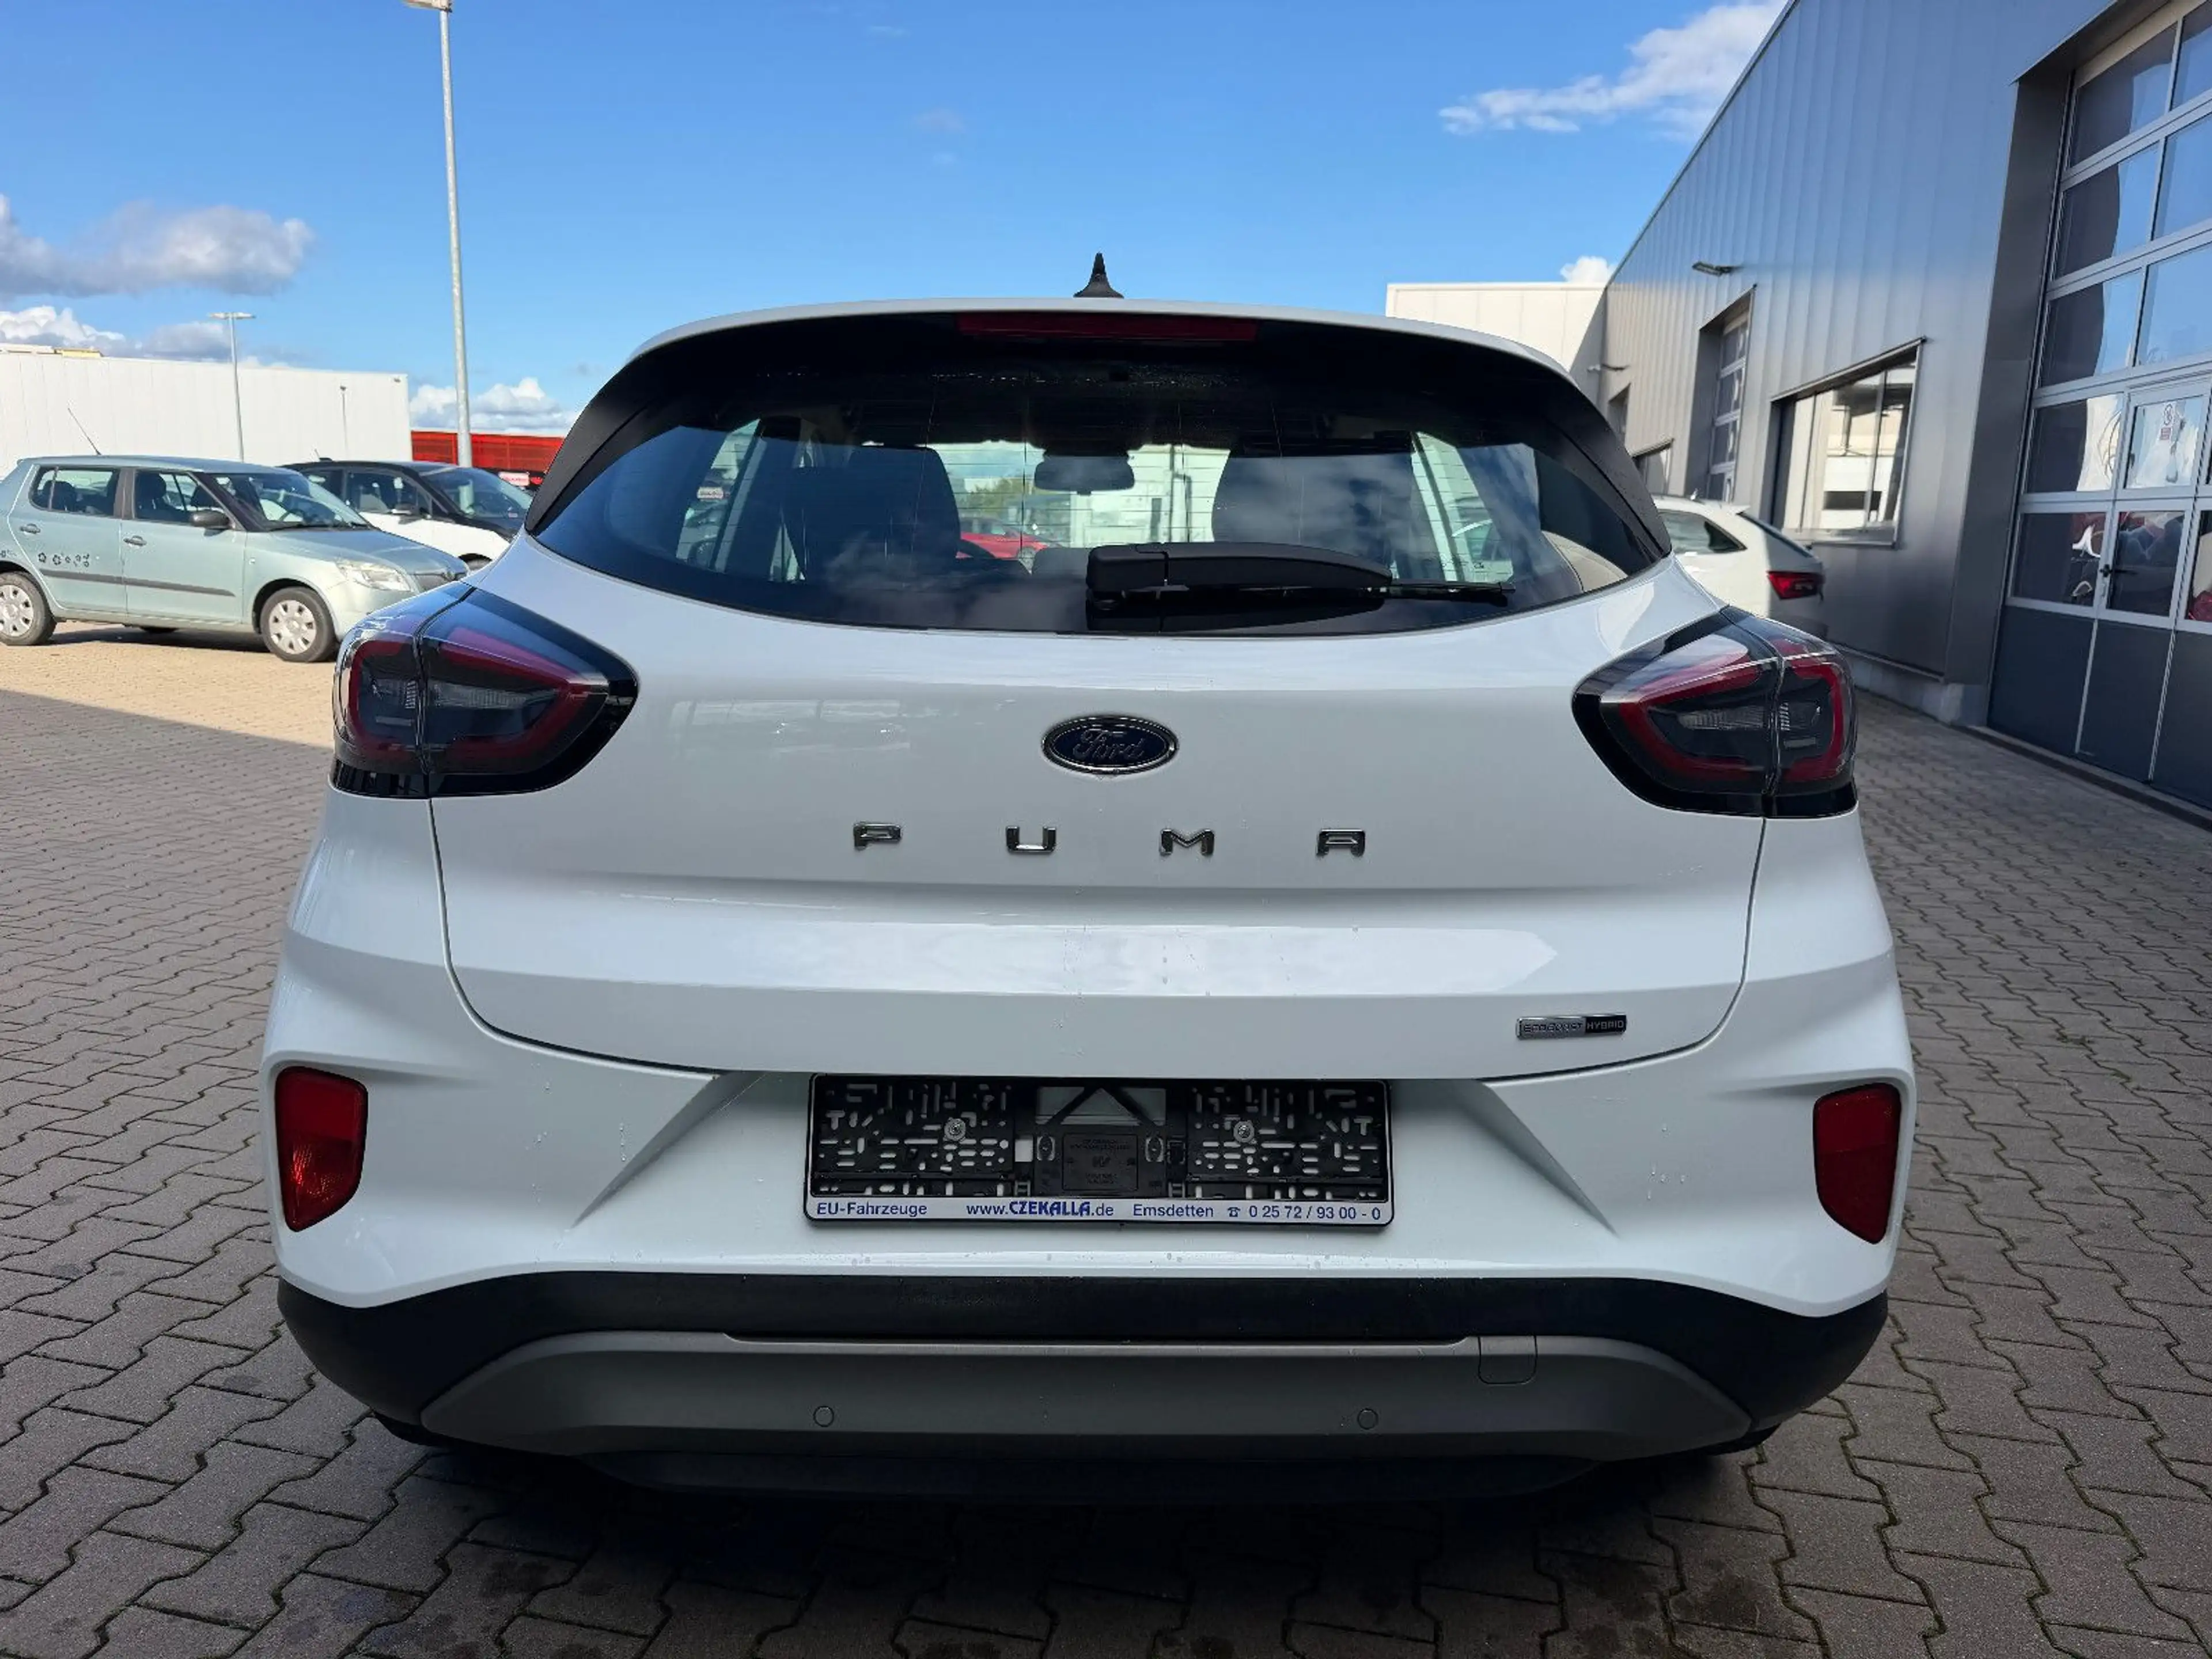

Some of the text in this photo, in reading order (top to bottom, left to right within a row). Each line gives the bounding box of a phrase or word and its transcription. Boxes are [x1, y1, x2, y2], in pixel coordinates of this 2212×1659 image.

[1073, 728, 1145, 760] Ford
[853, 822, 1366, 855] PUMA
[1587, 1020, 1624, 1030] HYBRID
[817, 1201, 927, 1217] EU-Fahrzeuge
[966, 1201, 1114, 1217] www.CZEKALLA.de
[1133, 1204, 1214, 1217] Emsdetten
